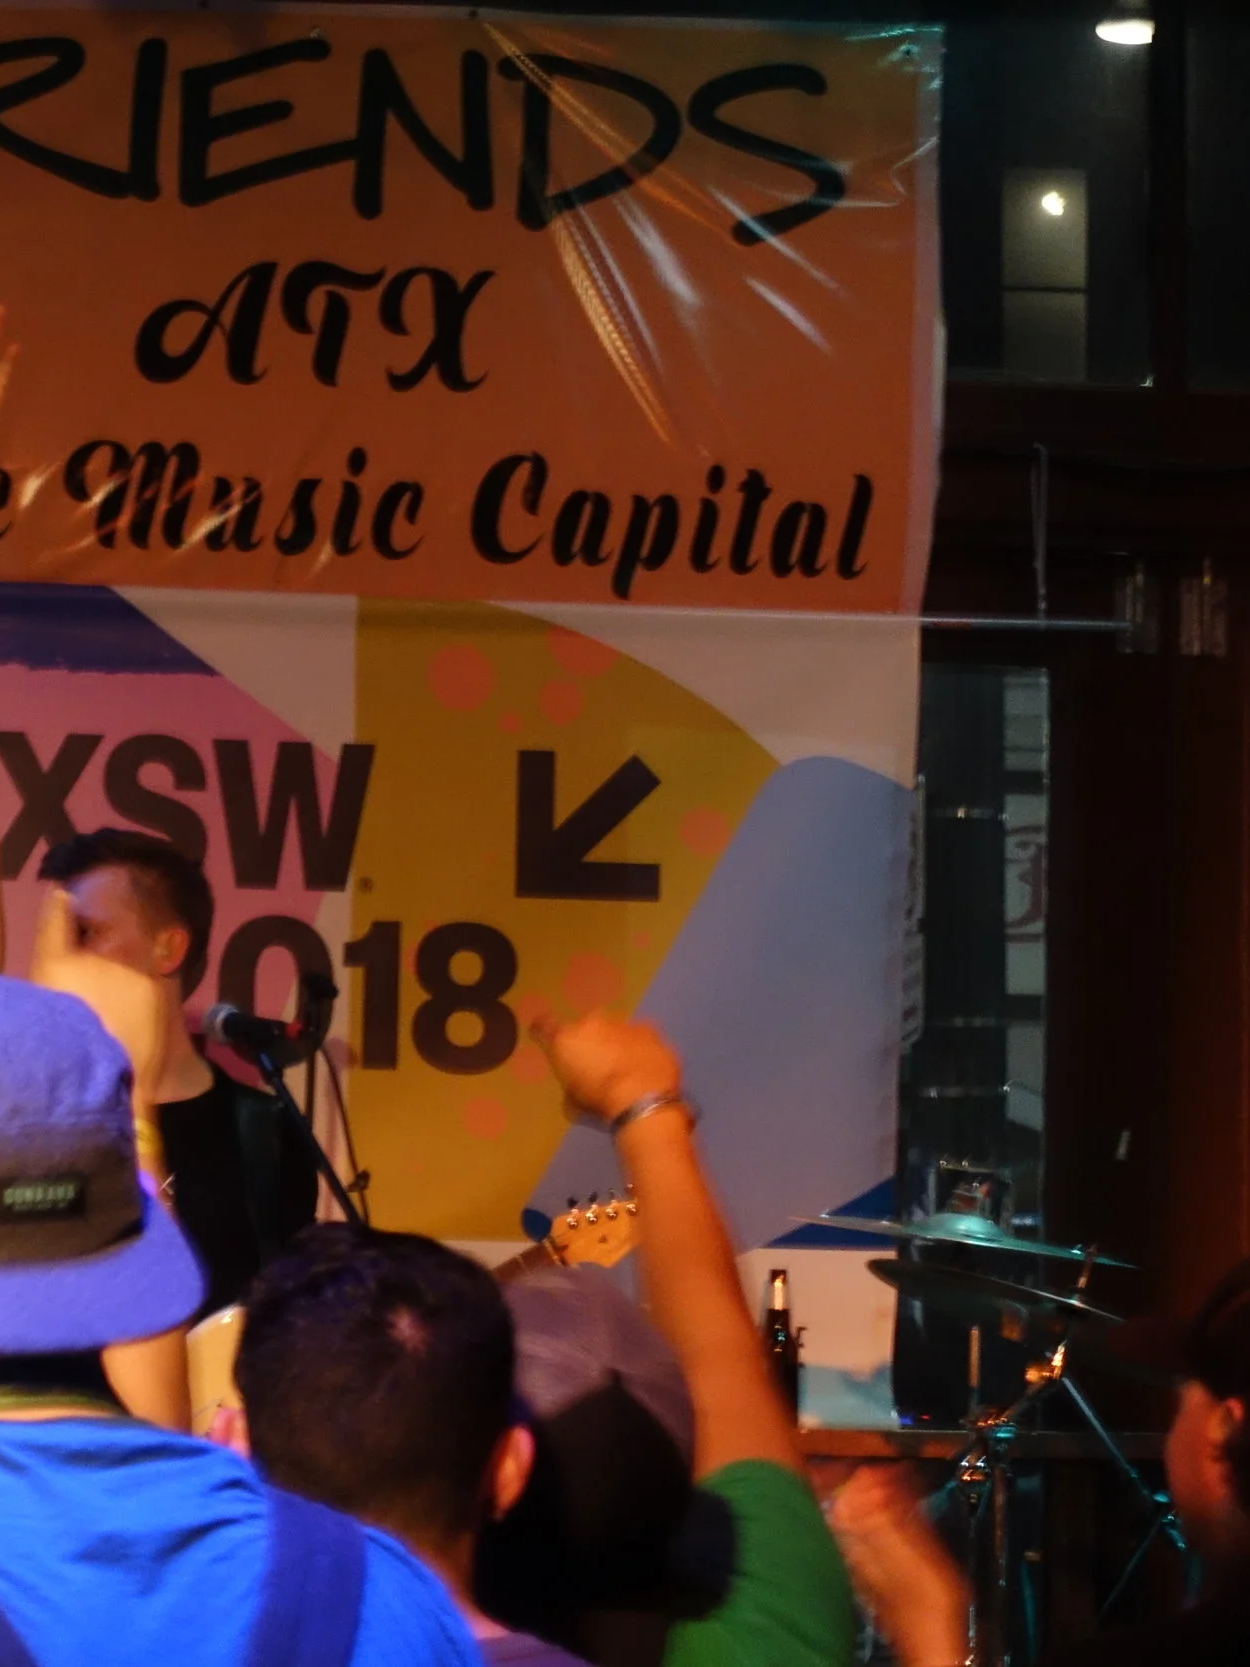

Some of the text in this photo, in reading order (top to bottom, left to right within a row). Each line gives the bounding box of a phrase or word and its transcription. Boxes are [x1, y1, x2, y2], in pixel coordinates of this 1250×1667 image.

[134, 260, 496, 392] ATX
[63, 439, 425, 560] Music
[469, 451, 875, 601] Capital
[182, 915, 518, 1075] 018
